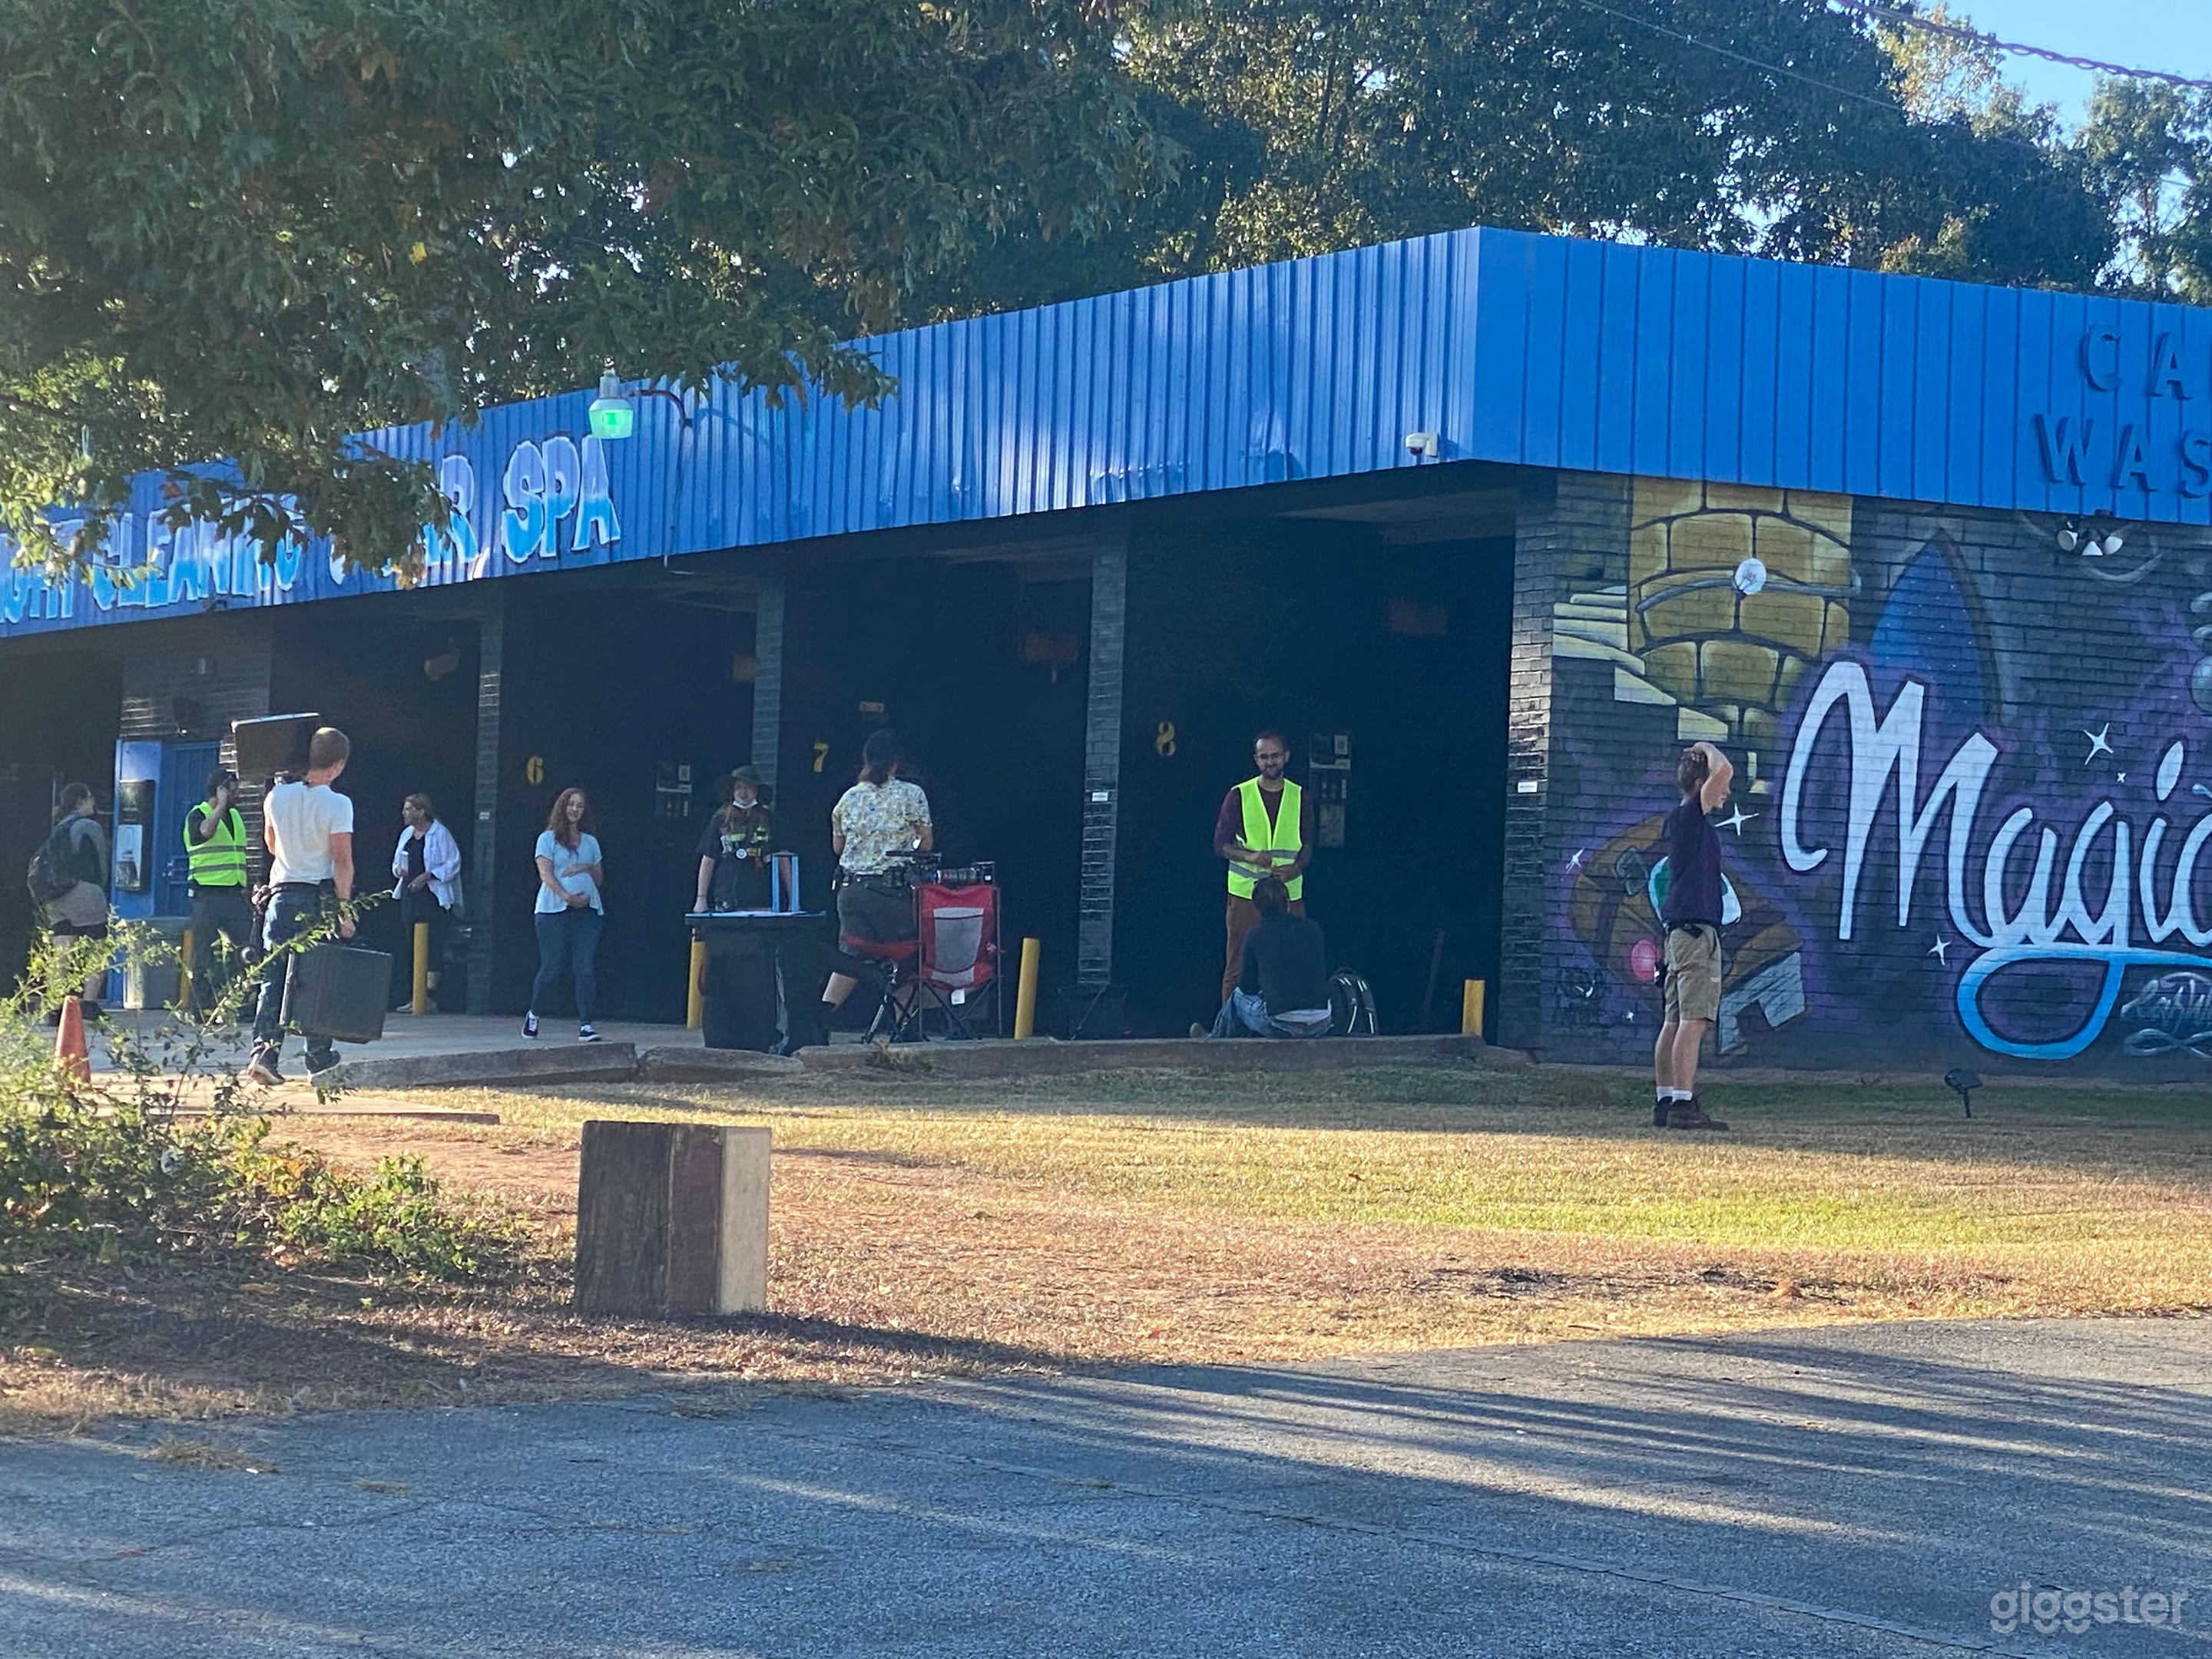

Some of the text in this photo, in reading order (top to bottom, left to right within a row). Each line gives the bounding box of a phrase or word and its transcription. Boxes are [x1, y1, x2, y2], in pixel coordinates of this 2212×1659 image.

[2080, 325, 2212, 399] CA
[501, 435, 621, 564] SPA
[813, 742, 829, 773] 7
[1156, 722, 1176, 757] 8
[526, 755, 544, 785] 6
[1780, 661, 2212, 1060] Magic
